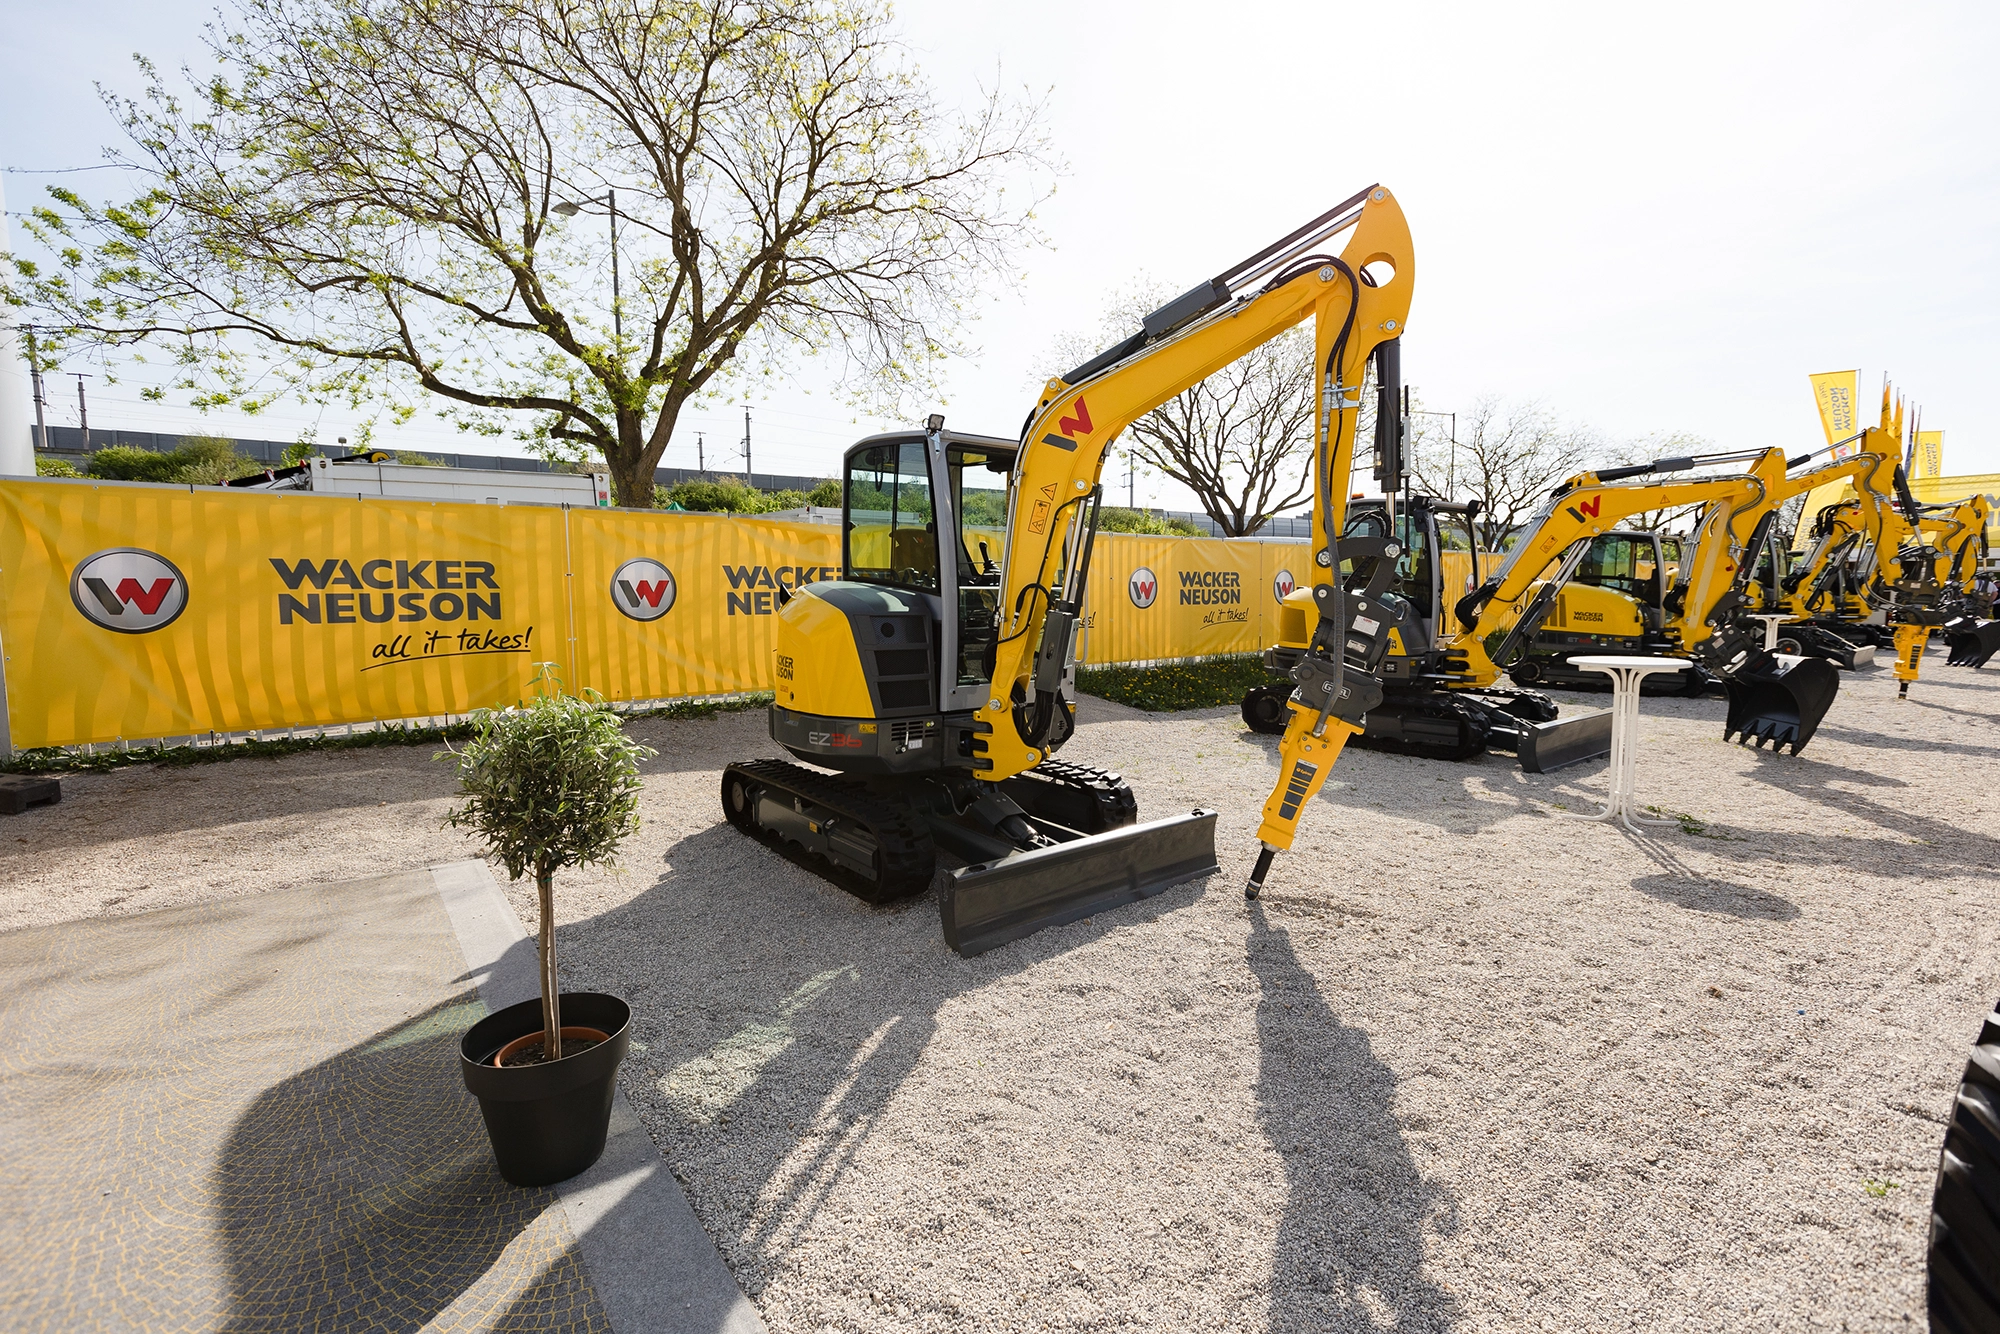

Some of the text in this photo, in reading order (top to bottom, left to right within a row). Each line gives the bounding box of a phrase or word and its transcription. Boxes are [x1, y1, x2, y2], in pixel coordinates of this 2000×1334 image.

[269, 558, 500, 590] WACKER
[1178, 571, 1240, 588] WACKER
[1180, 589, 1241, 605] NEUSON
[278, 592, 502, 625] NEUSON
[1203, 611, 1215, 624] all
[1227, 608, 1249, 620] takes!
[372, 626, 533, 658] all it takes!
[809, 731, 863, 748] EZ36
